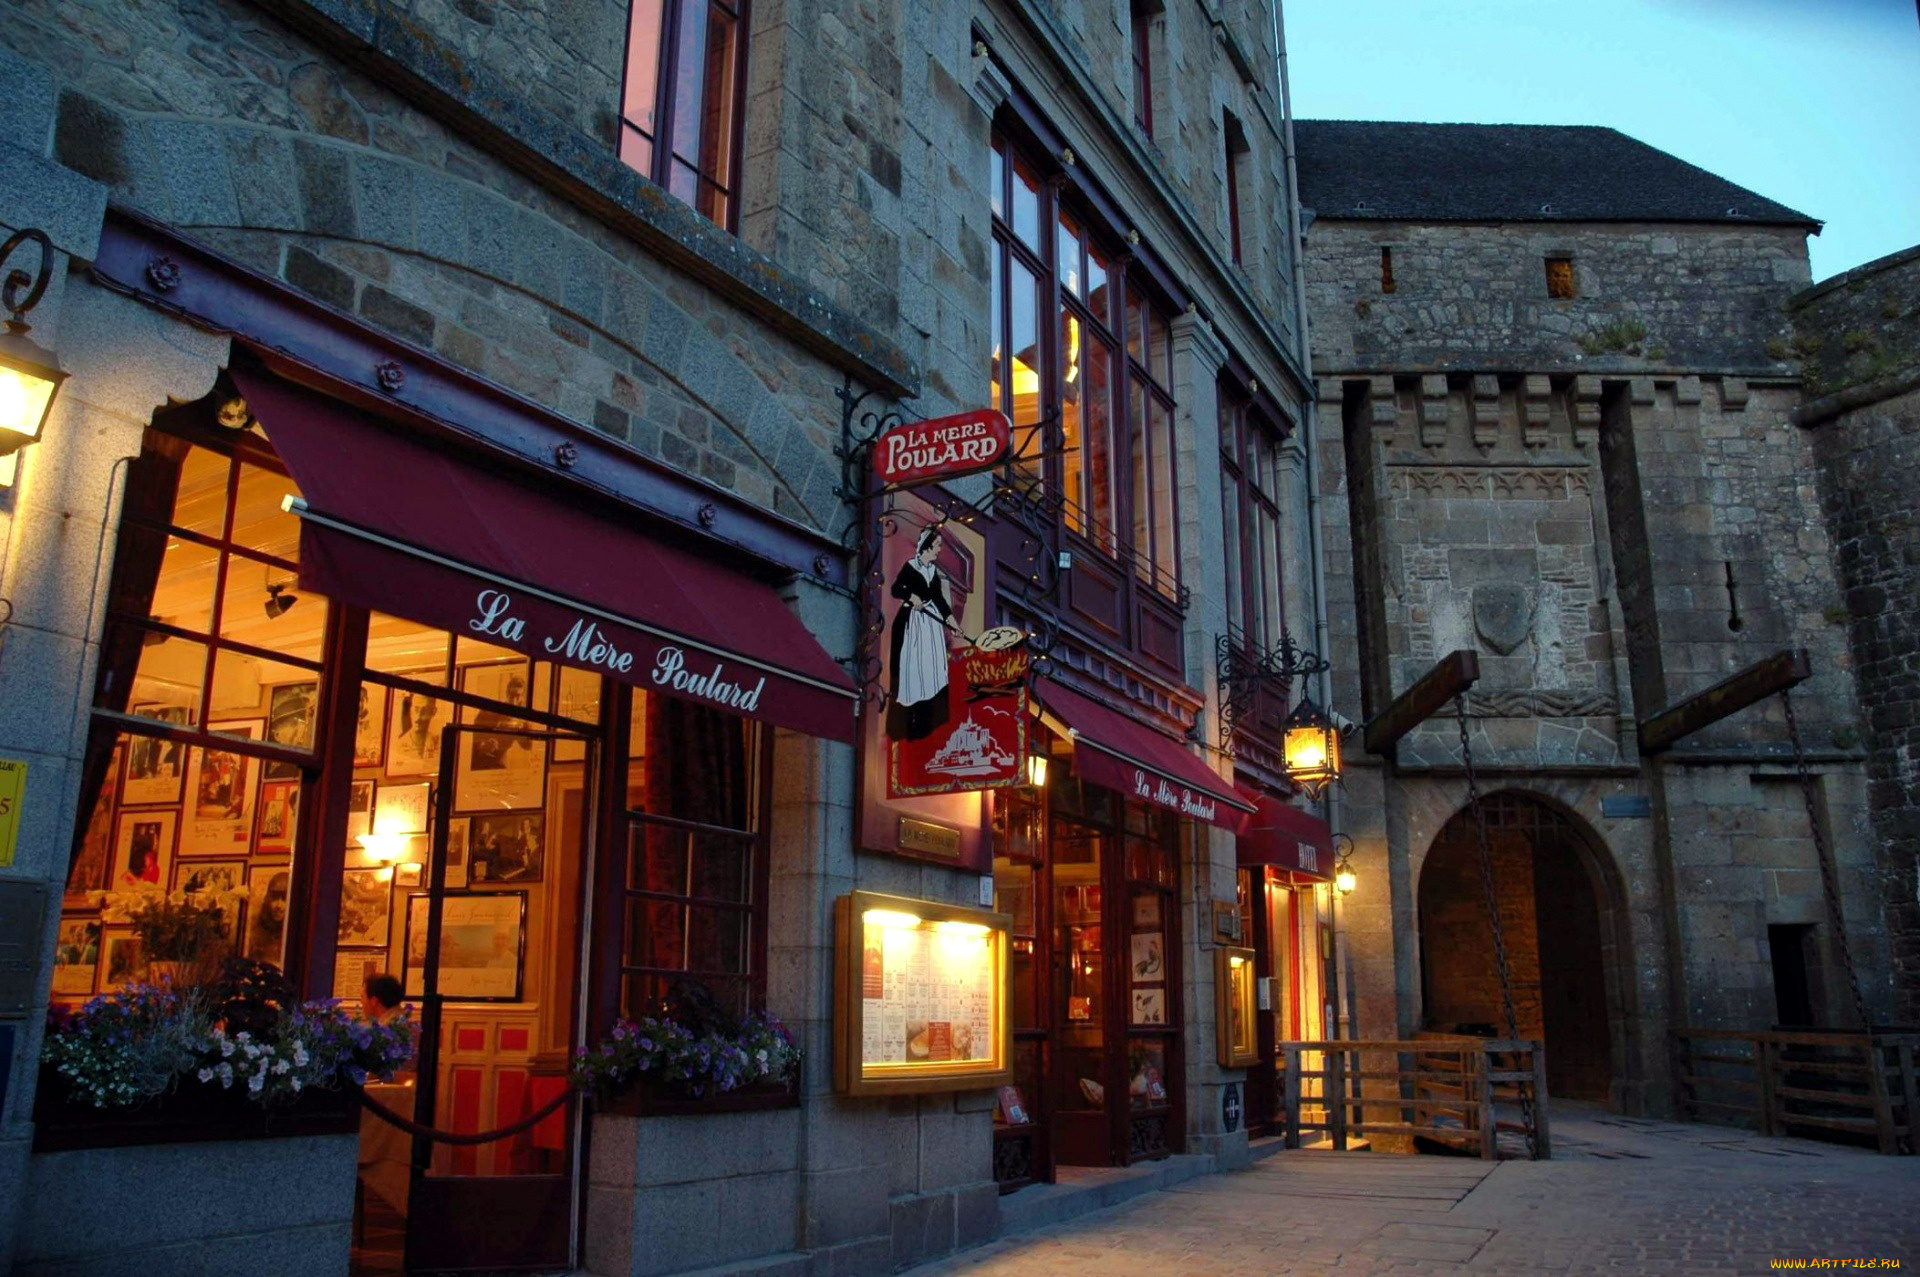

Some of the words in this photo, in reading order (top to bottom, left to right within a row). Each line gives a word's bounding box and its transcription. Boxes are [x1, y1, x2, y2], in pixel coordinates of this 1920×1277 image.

[886, 435, 997, 474] POULARD
[909, 430, 927, 447] LA
[933, 422, 986, 445] MERE
[469, 589, 524, 642] La
[544, 618, 634, 674] Mère
[651, 645, 766, 713] Poulard
[1135, 770, 1149, 798] La
[1153, 779, 1178, 808] Mère
[1181, 788, 1215, 821] Poulard
